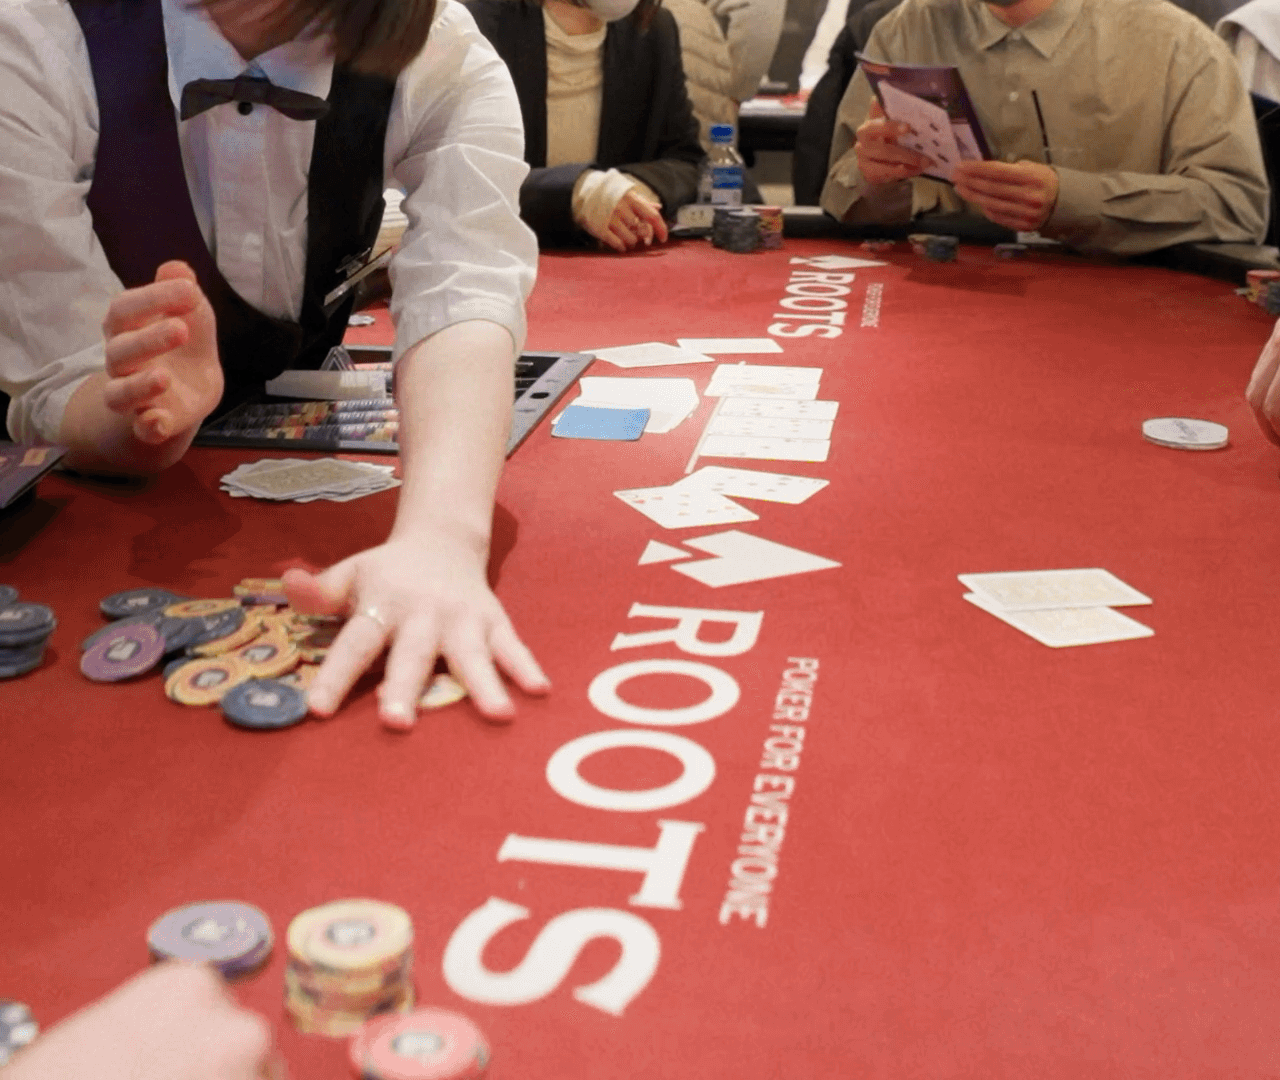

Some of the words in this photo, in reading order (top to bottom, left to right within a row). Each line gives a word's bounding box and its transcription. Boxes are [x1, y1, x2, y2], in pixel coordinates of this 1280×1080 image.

[767, 271, 856, 339] ROOTS
[773, 656, 819, 722] POKER
[760, 723, 806, 771] FOR
[442, 602, 765, 1018] ROOTS
[719, 773, 796, 930] EVERYONE
